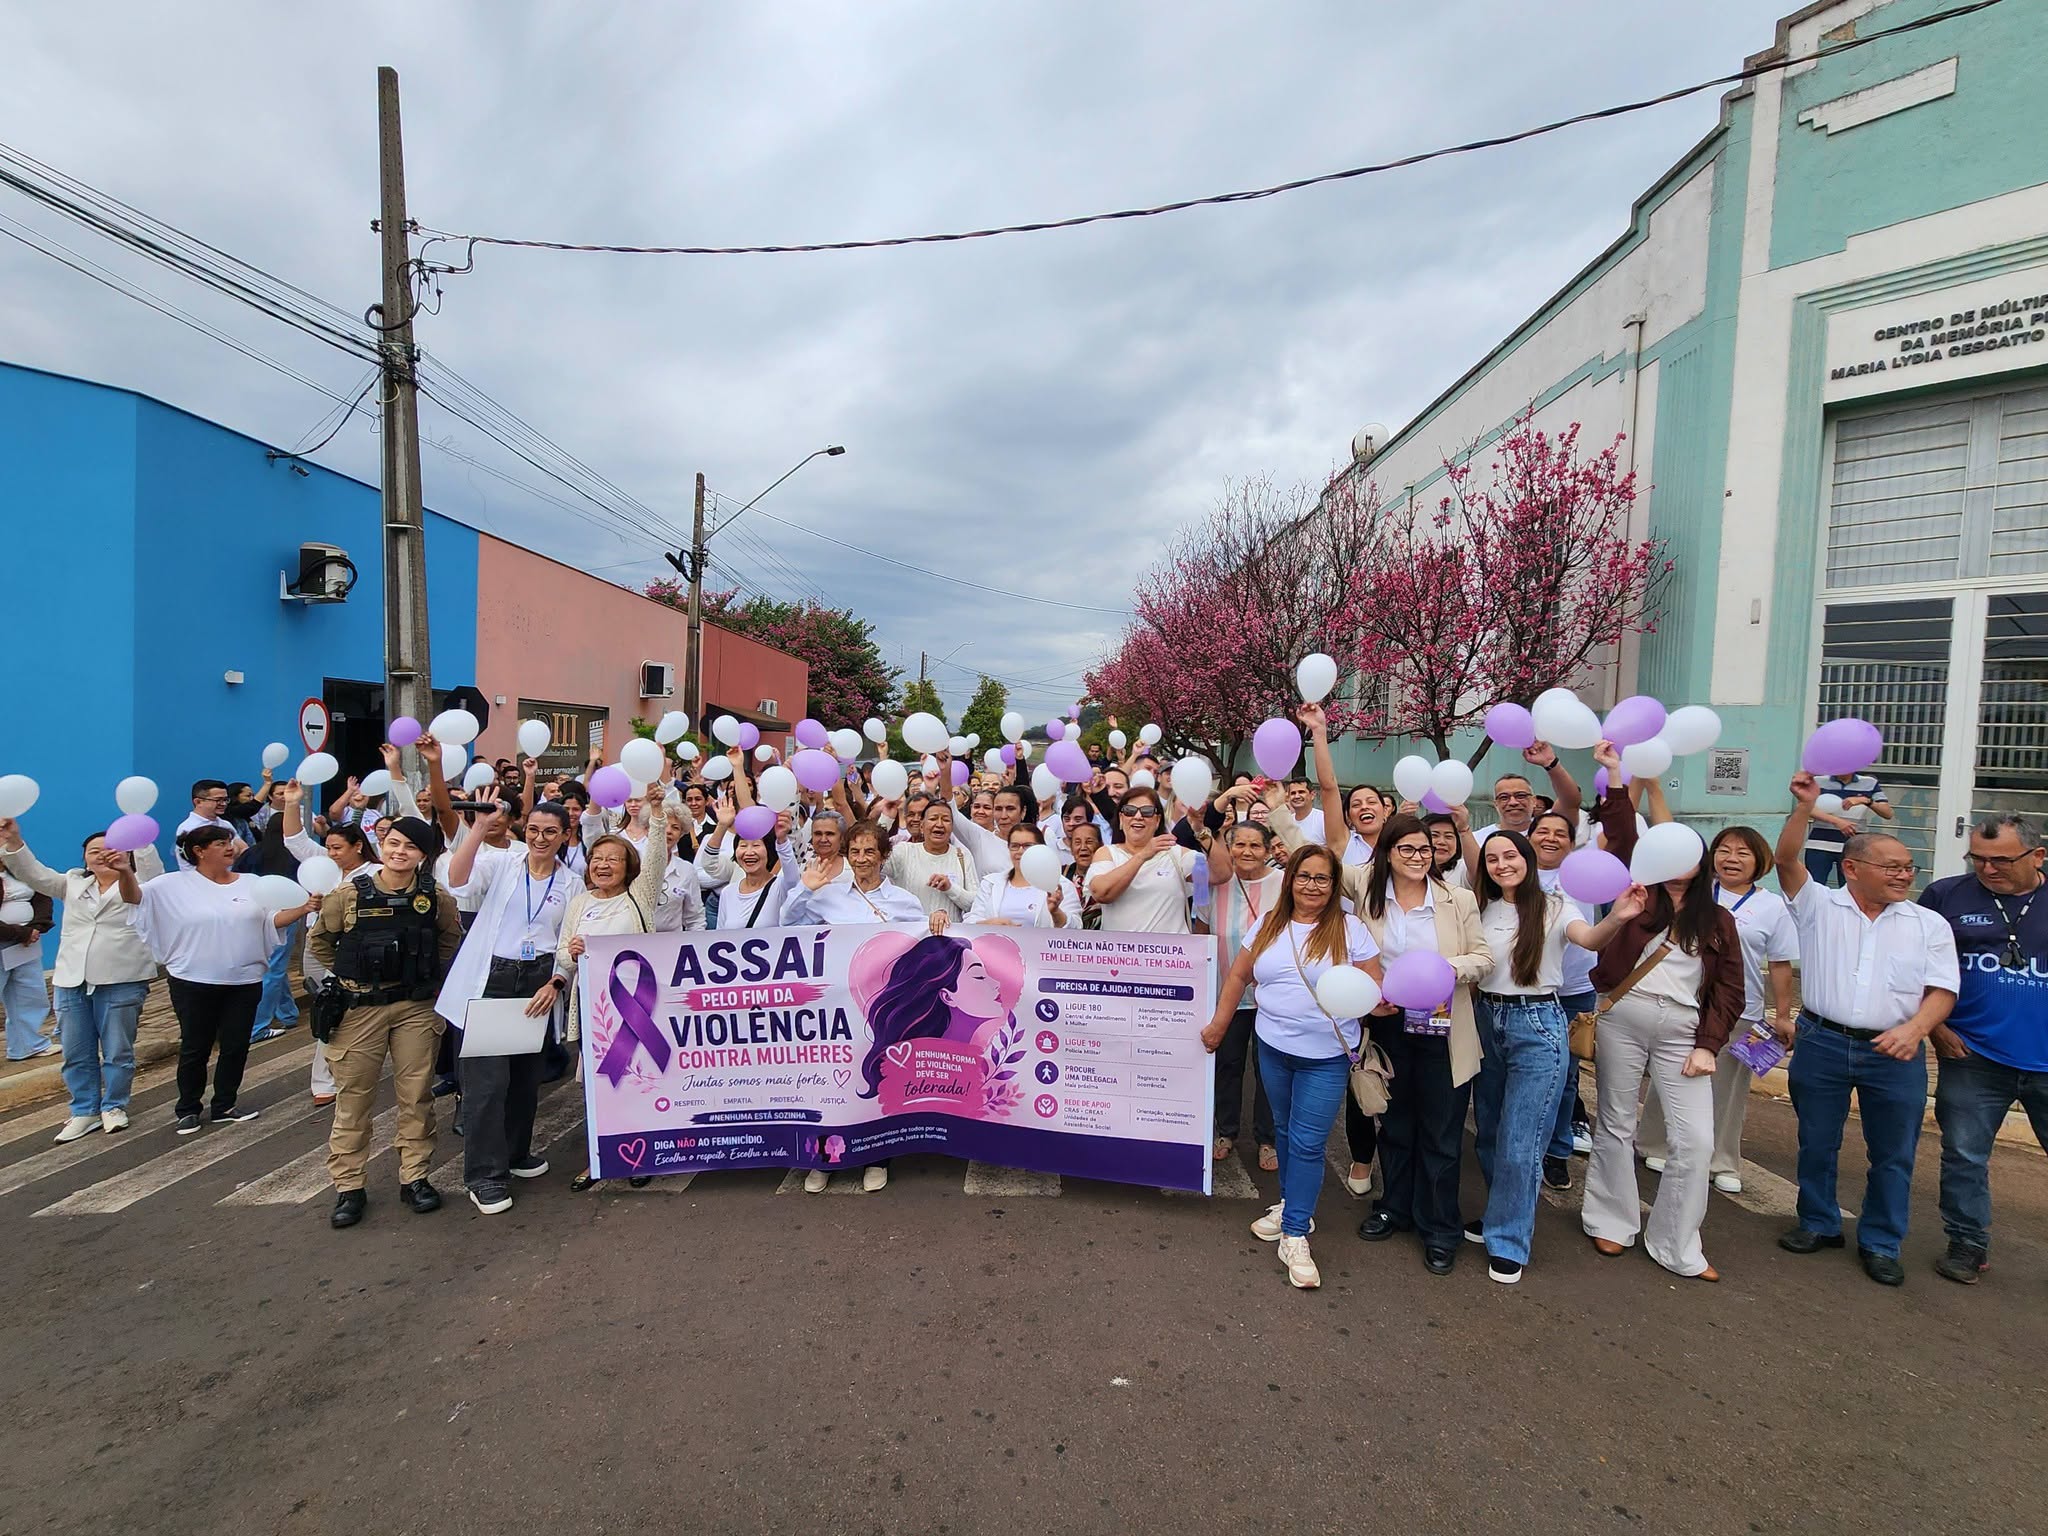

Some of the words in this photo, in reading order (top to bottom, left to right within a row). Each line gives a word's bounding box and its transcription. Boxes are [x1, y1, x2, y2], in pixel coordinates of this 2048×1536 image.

[1873, 317, 1944, 342] CENTRO
[1950, 309, 1975, 326] DE
[1900, 337, 1924, 352] DA
[1930, 316, 2024, 346] MEMÓRIA
[1831, 359, 1887, 381] MARIA
[1892, 349, 1943, 369] LYDIA
[1948, 328, 2045, 358] CESCATTO
[1047, 938, 1092, 951] VIOLÊNCIA
[1095, 940, 1114, 952] NÃO
[1117, 943, 1135, 953] TEM
[1137, 944, 1186, 956] DESCULPA.
[670, 929, 831, 987] ASSAÍ
[1040, 952, 1058, 962] TEM
[1060, 953, 1074, 963] LEI.
[1076, 954, 1094, 964] TEM
[1096, 954, 1142, 967] DENÚNCIA.
[1145, 958, 1163, 968] TEM
[1164, 958, 1193, 970] SAÍDA.
[1055, 981, 1088, 992] PRECISA
[1089, 983, 1100, 992] DE
[1101, 984, 1132, 995] AJUDA?
[1133, 986, 1176, 997] DENUNCIE!
[1998, 976, 2048, 989] SPORT
[701, 991, 738, 1008] PELO
[742, 988, 769, 1005] FIM
[773, 987, 795, 1003] DA
[1065, 1002, 1087, 1011] LIGUE
[1089, 1004, 1102, 1012] 180
[1138, 1007, 1172, 1015] Atendimento
[668, 1004, 853, 1048] VIOLÊNCIA
[1065, 1038, 1086, 1046] LIGUE
[1088, 1040, 1102, 1048] 190
[678, 1048, 752, 1070] CONTRA
[757, 1044, 853, 1066] MULHERES
[915, 1050, 951, 1061] NENHUMA
[952, 1053, 976, 1065] FORMA
[915, 1060, 927, 1068] DE
[927, 1060, 963, 1073] VIOLÊNCIA
[916, 1070, 935, 1078] DEVE
[936, 1071, 949, 1080] SER
[1064, 1065, 1096, 1075] PROCURE
[682, 1074, 725, 1092] Juntas
[728, 1077, 762, 1088] somos
[765, 1074, 794, 1086] mais
[796, 1072, 830, 1090] fortes.
[1064, 1073, 1080, 1081] UMA
[1081, 1075, 1118, 1084] DELEGACIA
[904, 1079, 972, 1097] tolerada!
[1064, 1098, 1081, 1107] REDE
[1091, 1101, 1111, 1109] APOIO
[709, 1113, 753, 1122] #NENHUMA
[754, 1111, 773, 1120] ESTÁ
[774, 1111, 807, 1120] SOZINHA
[654, 1140, 675, 1151] DIGA
[677, 1137, 696, 1148] NÃO
[698, 1137, 710, 1147] AO
[712, 1133, 765, 1146] FEMINICÍDIO.
[851, 1143, 871, 1153] cidade
[871, 1140, 884, 1148] mais
[905, 1133, 919, 1142] justa
[862, 1130, 899, 1143] compromisso
[654, 1152, 687, 1166] Escolha
[729, 1147, 761, 1160] Escolha
